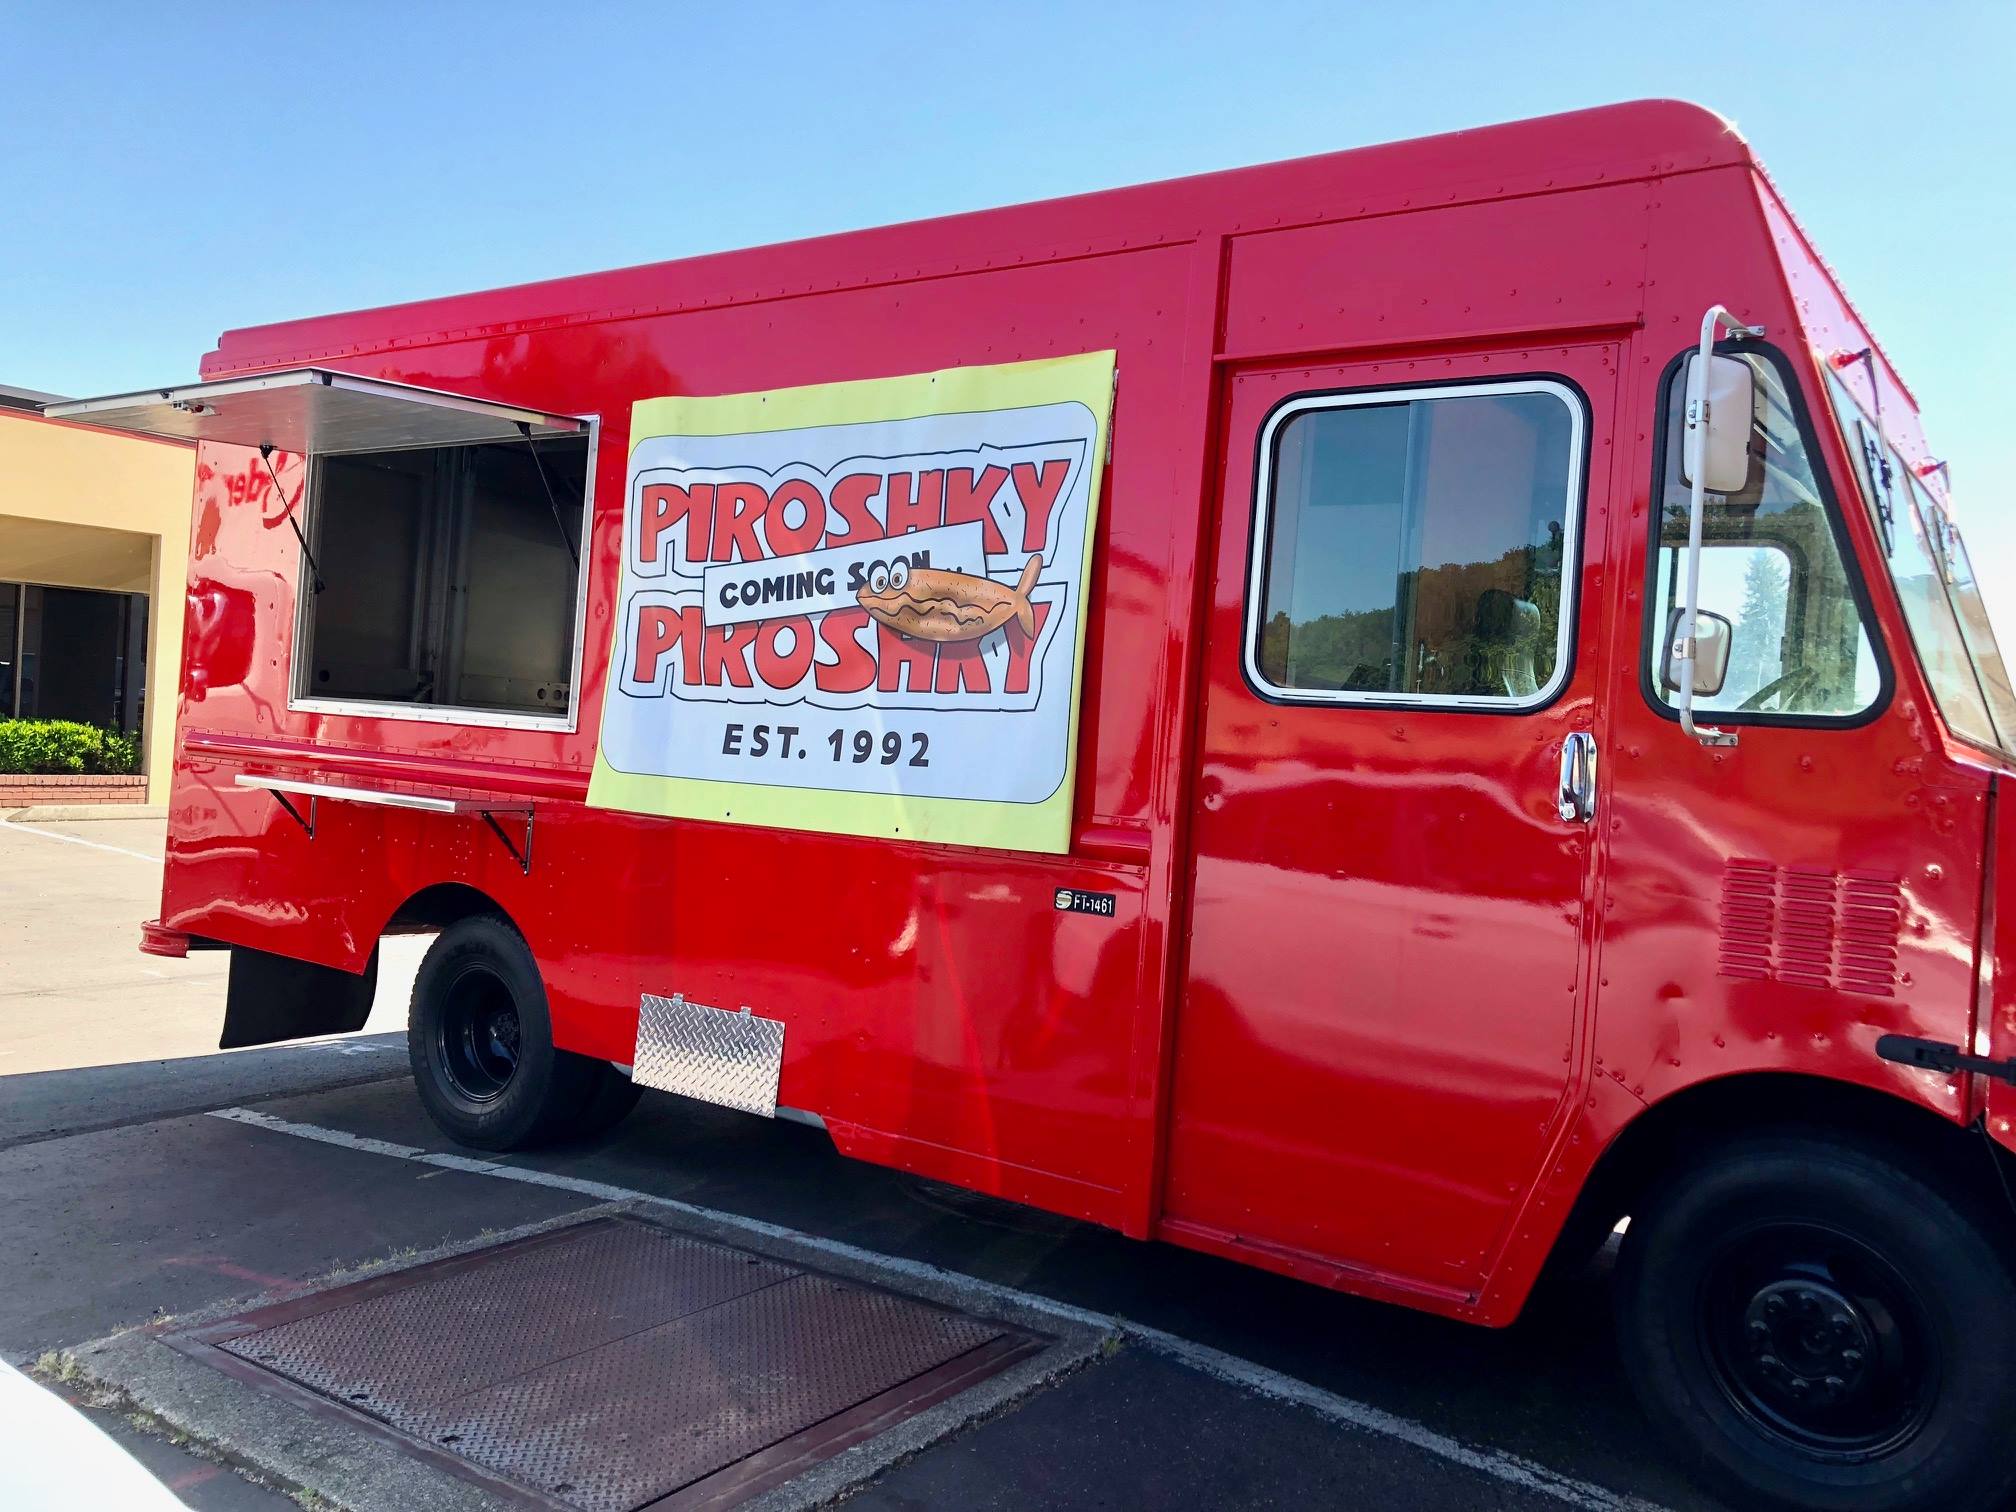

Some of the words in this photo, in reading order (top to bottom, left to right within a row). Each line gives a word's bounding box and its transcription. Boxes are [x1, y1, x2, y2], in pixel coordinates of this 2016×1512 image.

[639, 459, 1071, 562] PIROSHKY
[719, 569, 835, 609] COMING
[722, 723, 807, 761] EST.
[827, 729, 931, 768] 1992
